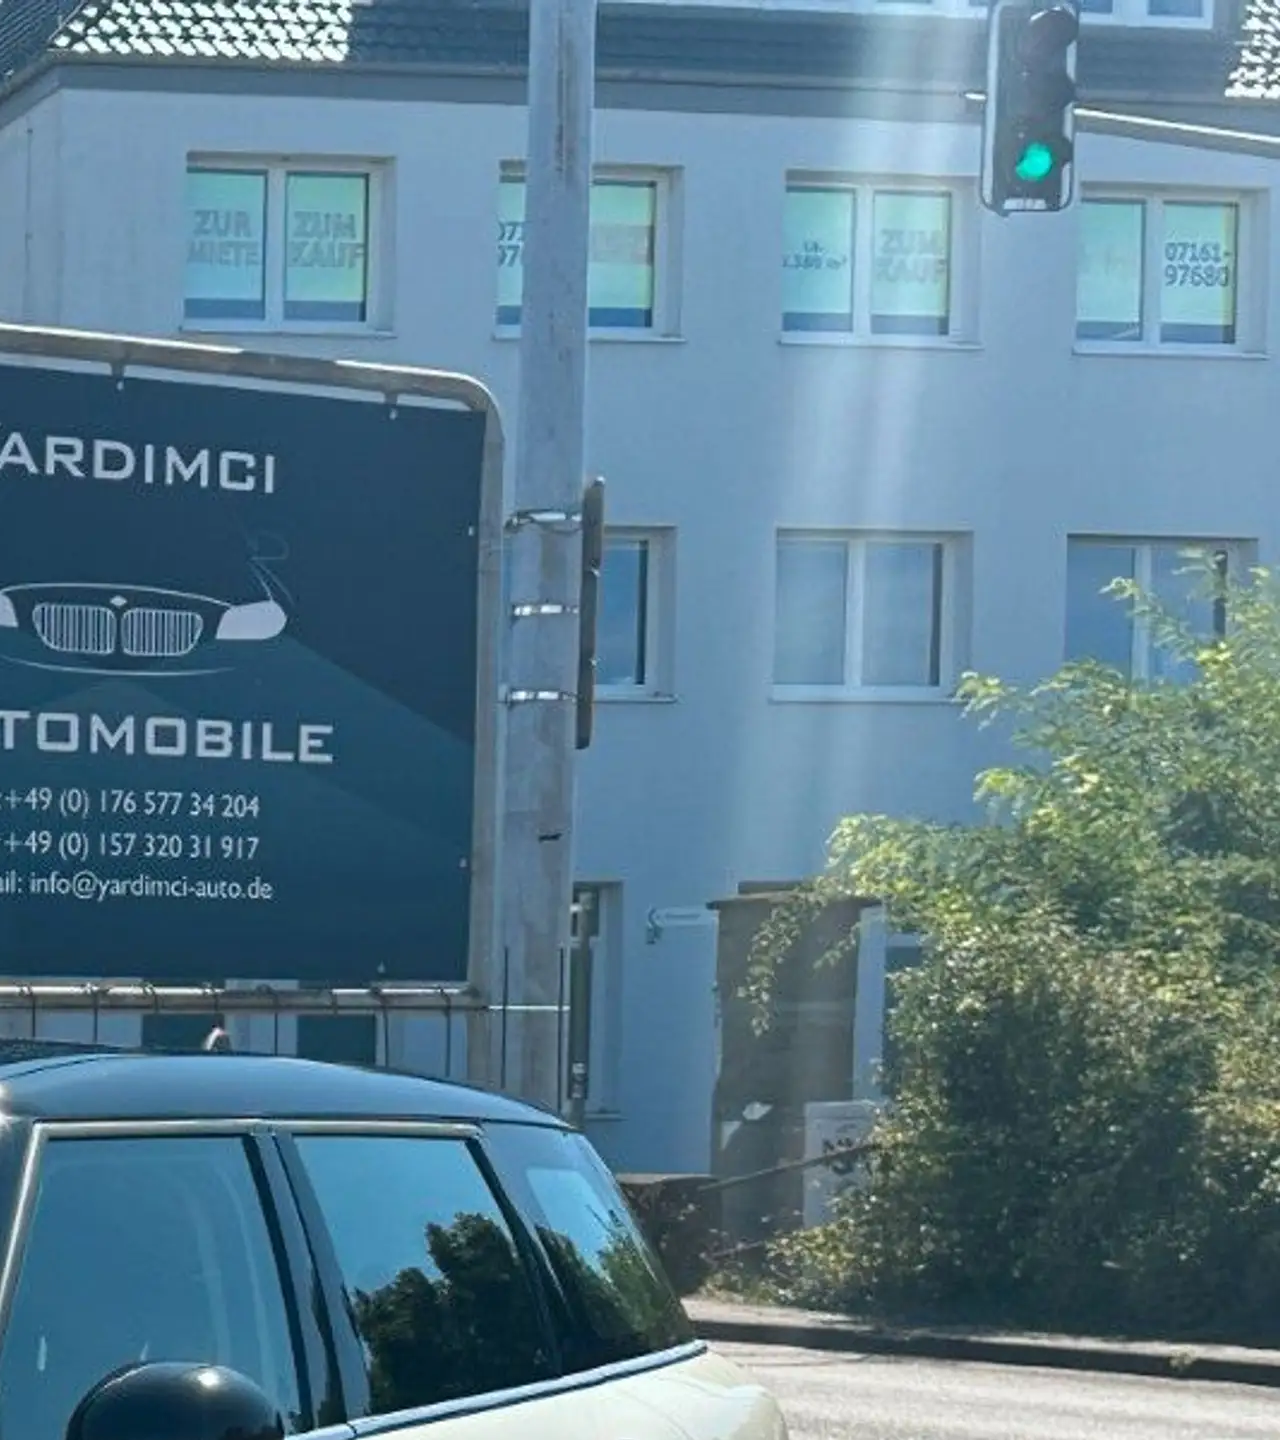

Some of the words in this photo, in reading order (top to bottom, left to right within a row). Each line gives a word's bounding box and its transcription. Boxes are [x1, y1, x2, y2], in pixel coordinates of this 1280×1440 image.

[192, 209, 253, 238] ZUR
[58, 787, 90, 818] (0)
[100, 788, 138, 814] 176
[143, 790, 183, 817] 577
[188, 791, 216, 818] 34
[220, 793, 260, 820] 204
[57, 830, 90, 862] (0)
[99, 832, 138, 857] 157
[142, 833, 183, 859] 320
[188, 834, 213, 859] 31
[220, 835, 260, 860] 917
[29, 868, 274, 903] info@yardimci-auto.de
